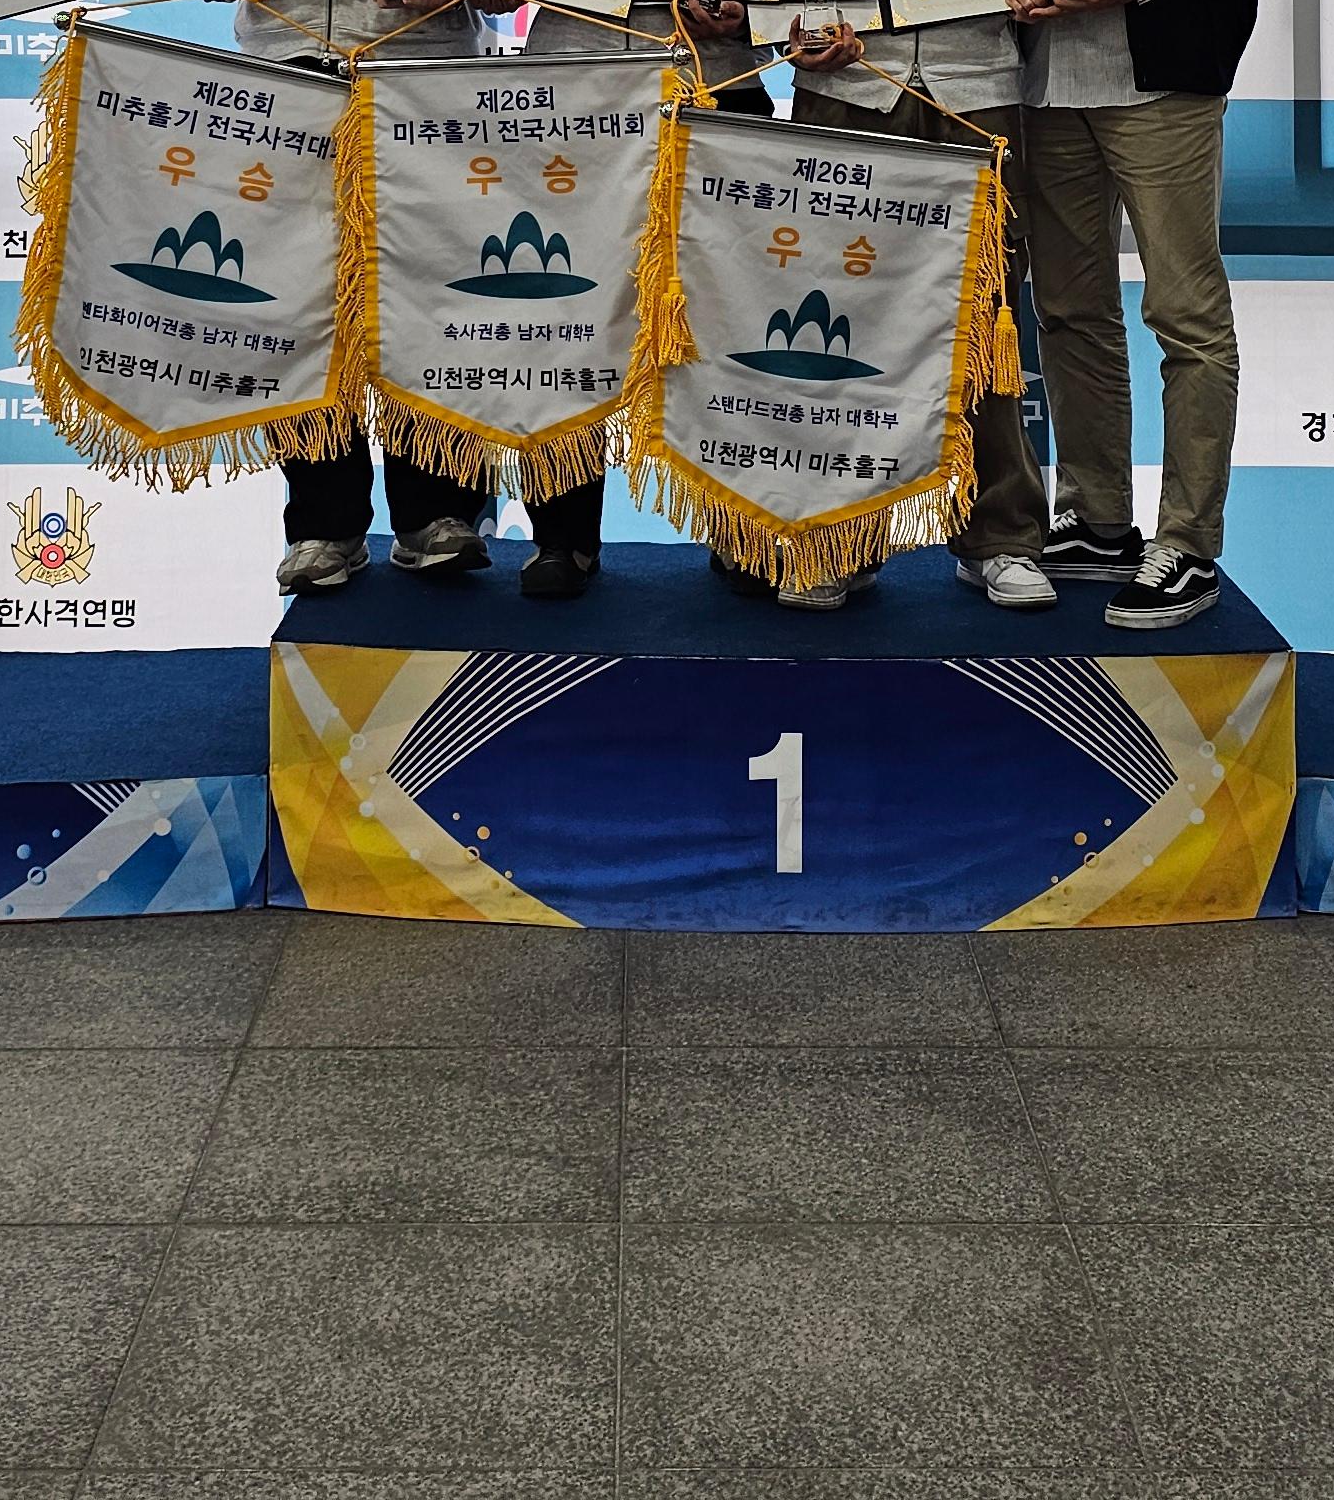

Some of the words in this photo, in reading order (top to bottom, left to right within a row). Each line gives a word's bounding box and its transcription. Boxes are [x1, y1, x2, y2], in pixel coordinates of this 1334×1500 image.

[193, 80, 275, 118] 제26회
[476, 86, 555, 113] 제26회
[97, 90, 197, 134] 미추홀기
[207, 114, 338, 160] 전국사격대
[393, 119, 489, 145] 미추홀기
[498, 113, 645, 142] 전국사격대회
[792, 158, 873, 190] 제26회
[702, 176, 798, 211] 미추홀기
[807, 191, 952, 229] 전국사격대회
[202, 327, 238, 348] 남자
[244, 335, 296, 356] 대학부
[443, 323, 511, 341] 속사권총
[517, 323, 552, 341] 남자
[559, 323, 595, 342] 대학부
[80, 347, 183, 386] 인천광역시
[189, 366, 281, 399] 미추홀구
[423, 367, 532, 391] 인천광역시
[540, 367, 620, 392] 미추홀구
[707, 395, 805, 423] 스탠다드권총
[810, 407, 840, 427] 남자
[847, 409, 899, 429] 대학부
[699, 439, 801, 471] 인천광역시
[809, 451, 900, 480] 미추홀구
[749, 733, 802, 873] 1
